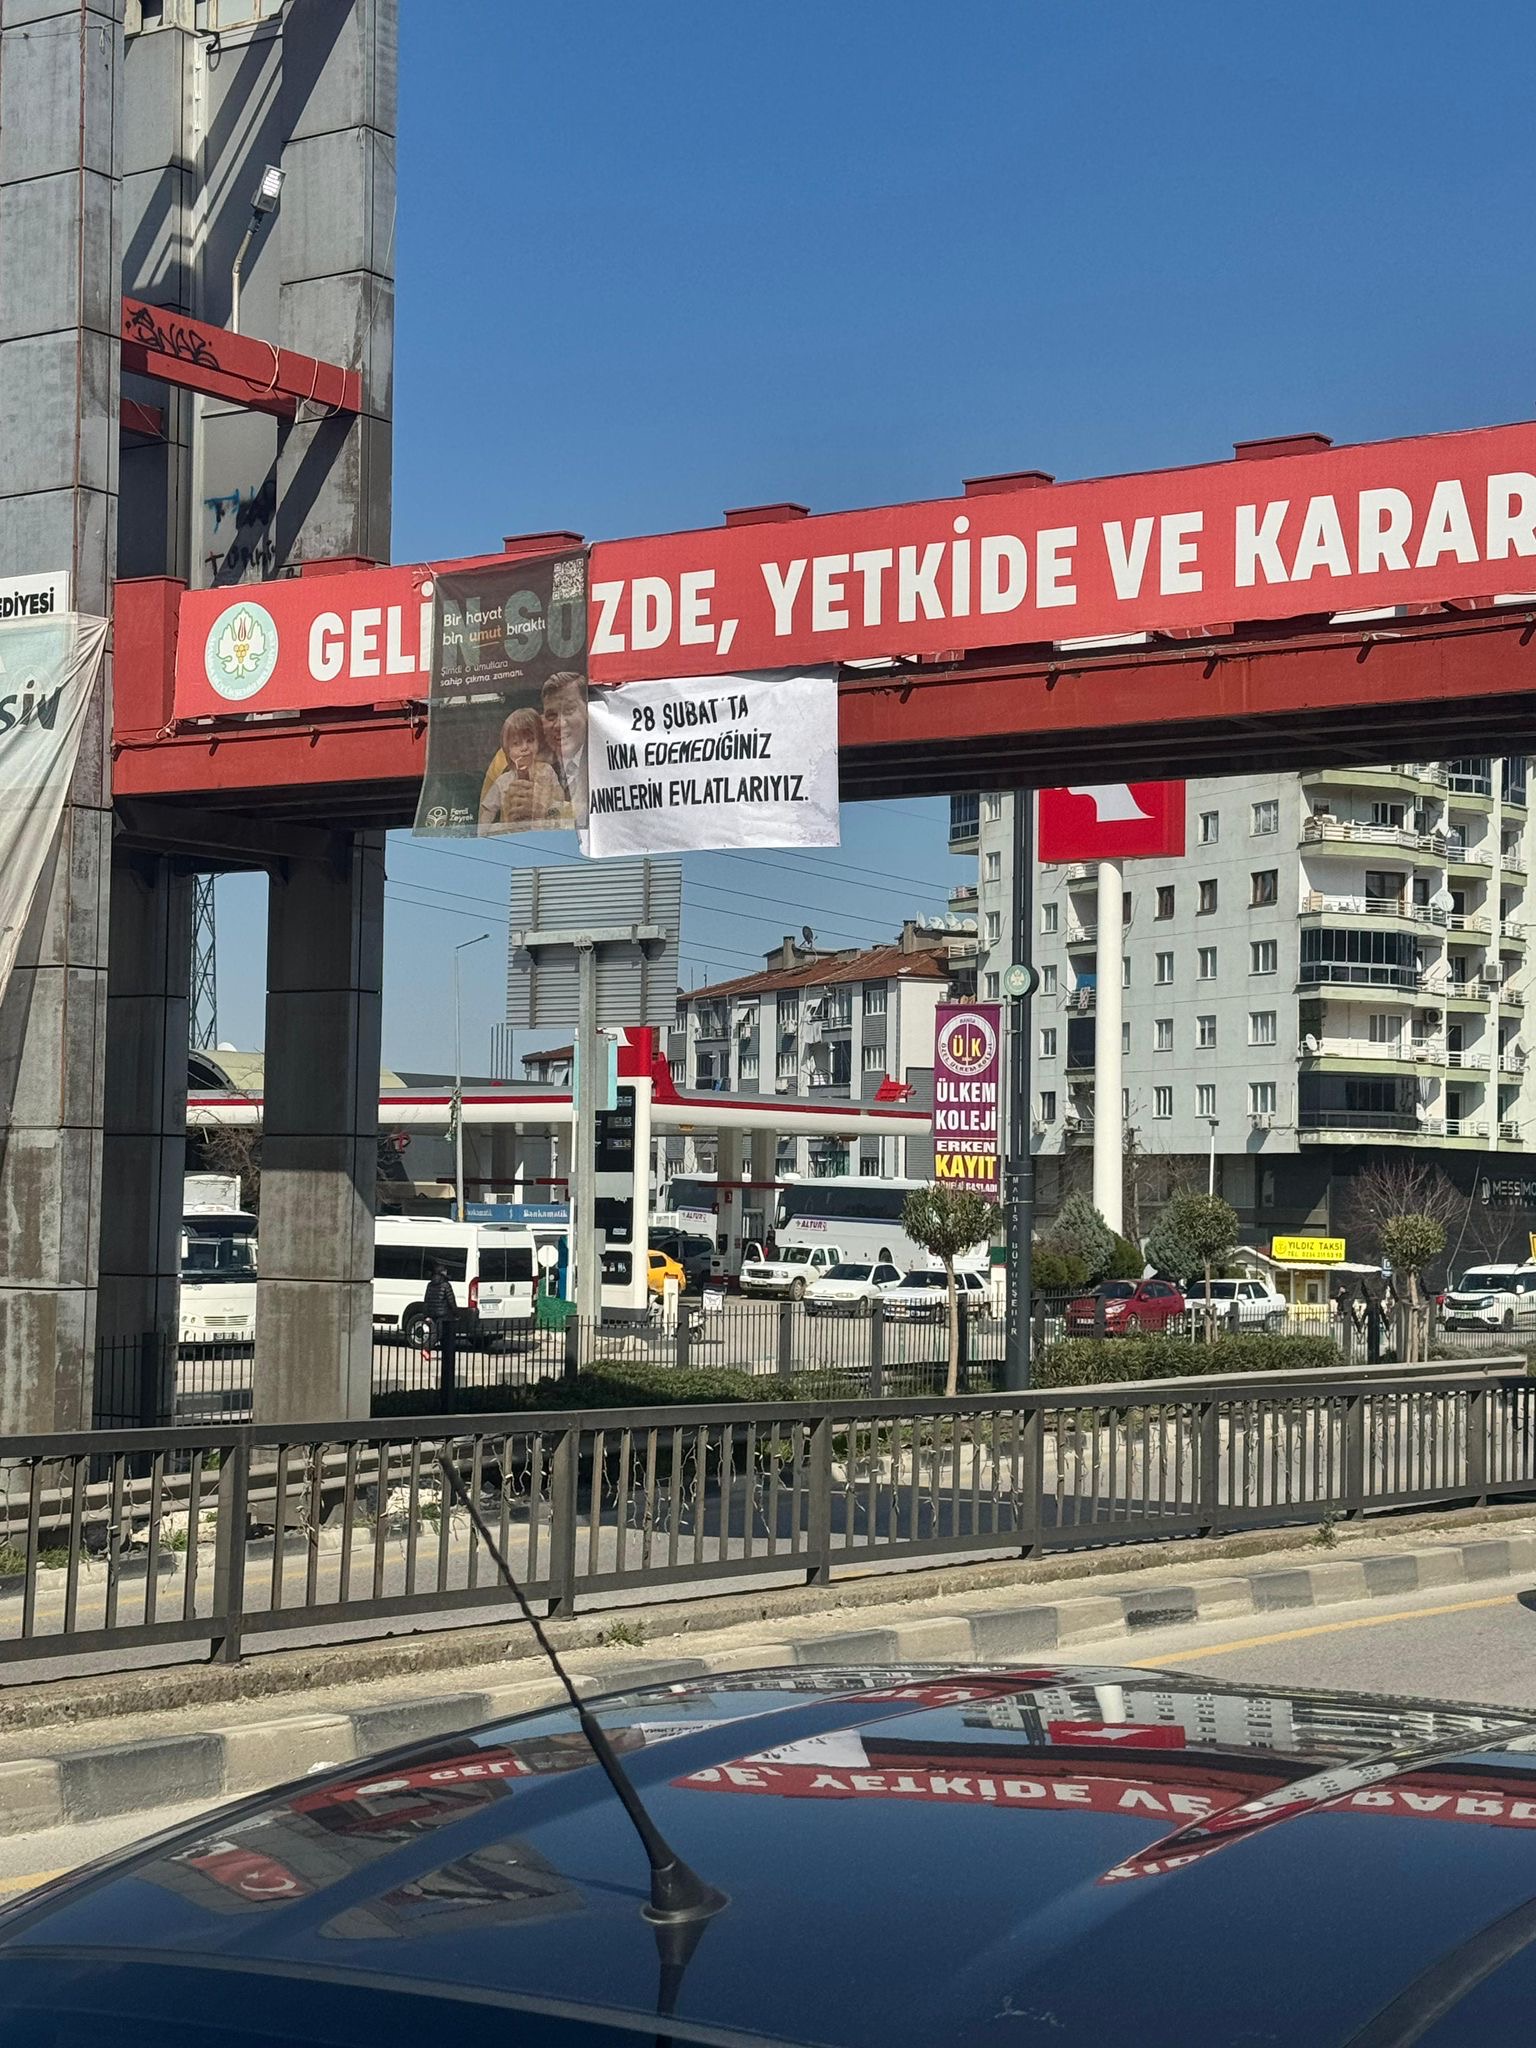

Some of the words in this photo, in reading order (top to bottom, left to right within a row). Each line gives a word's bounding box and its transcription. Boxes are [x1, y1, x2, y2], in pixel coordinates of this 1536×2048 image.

[760, 515, 1078, 637] YETKİDE
[1102, 510, 1204, 601] VE
[1235, 472, 1536, 588] KARAR
[443, 613, 462, 627] Bir
[466, 606, 503, 626] hayat
[443, 632, 463, 646] bin
[469, 627, 502, 642] umut
[507, 618, 546, 636] bıraktı
[474, 660, 508, 672] umutlara
[440, 676, 462, 687] sahip
[465, 674, 490, 685] çıkma
[631, 706, 656, 732] 28
[606, 740, 638, 771] İKNA
[644, 728, 772, 767] EDEMEDİĞİNİZ
[590, 778, 663, 814] ANNELERİN
[669, 775, 809, 807] EVLATLARIYIZ.
[937, 1078, 996, 1103] ÜLKEM
[935, 1107, 996, 1132] KOLEJİ
[937, 1140, 996, 1153] ERKEN
[935, 1154, 996, 1180] KAYIT
[523, 1208, 568, 1218] Bankamatik
[1288, 1241, 1314, 1250] YILDIZ
[1319, 1241, 1343, 1251] TAKSİ
